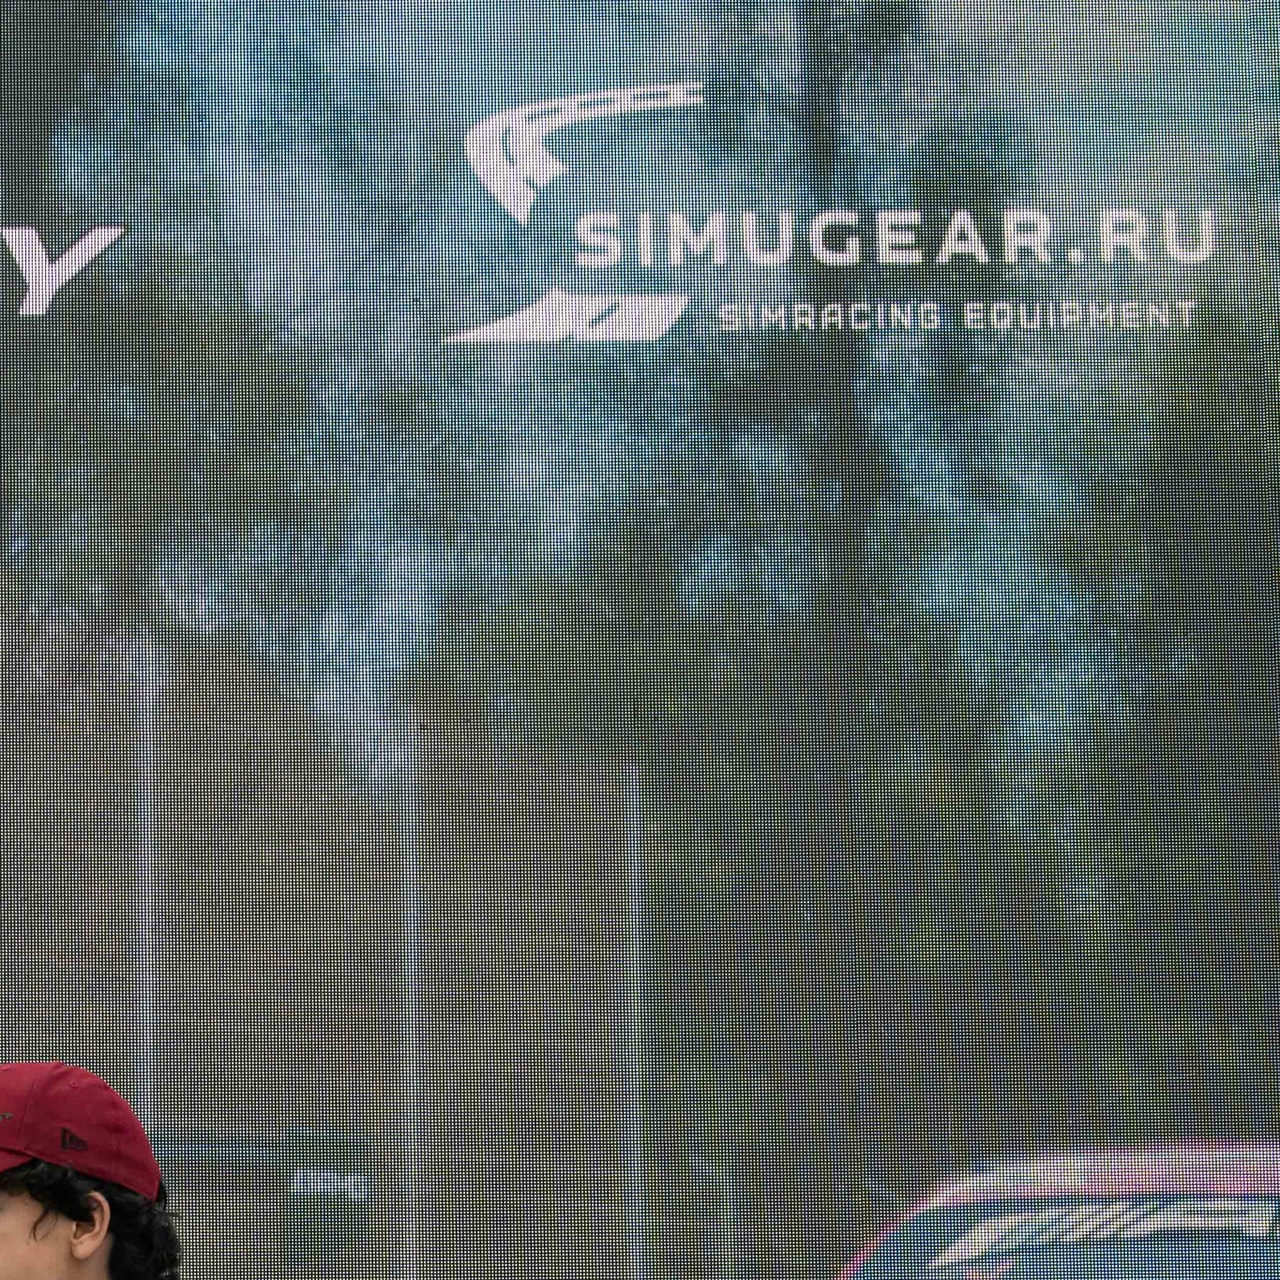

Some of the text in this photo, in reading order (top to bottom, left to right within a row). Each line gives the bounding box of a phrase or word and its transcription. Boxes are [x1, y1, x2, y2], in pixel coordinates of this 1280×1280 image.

[575, 209, 1218, 267] SIMUGEAR.RU
[719, 299, 1198, 333] SIMRACING EQUIPMENT
